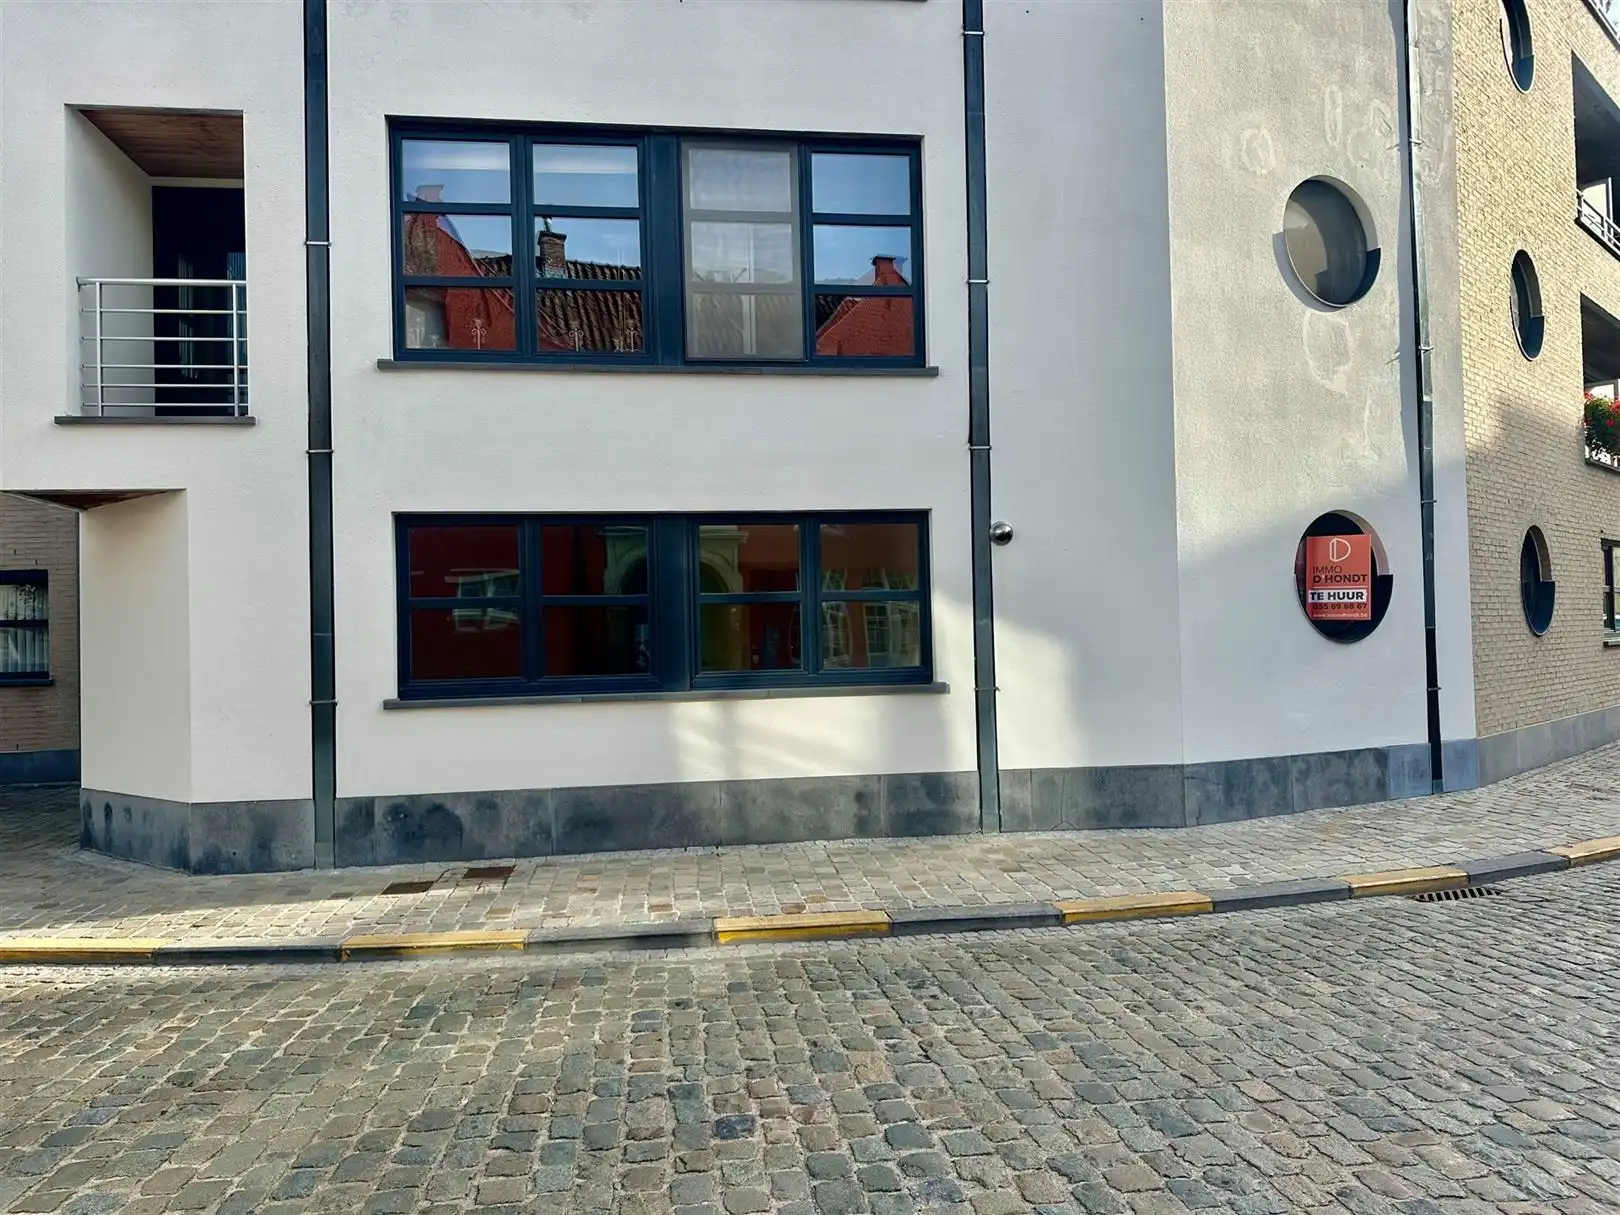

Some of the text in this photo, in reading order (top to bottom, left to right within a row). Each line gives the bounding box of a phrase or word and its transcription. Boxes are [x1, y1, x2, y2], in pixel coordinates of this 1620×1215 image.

[1313, 565, 1342, 574] IMMO
[1313, 574, 1368, 583] D'HONDT
[1310, 592, 1364, 600] TE HUUR
